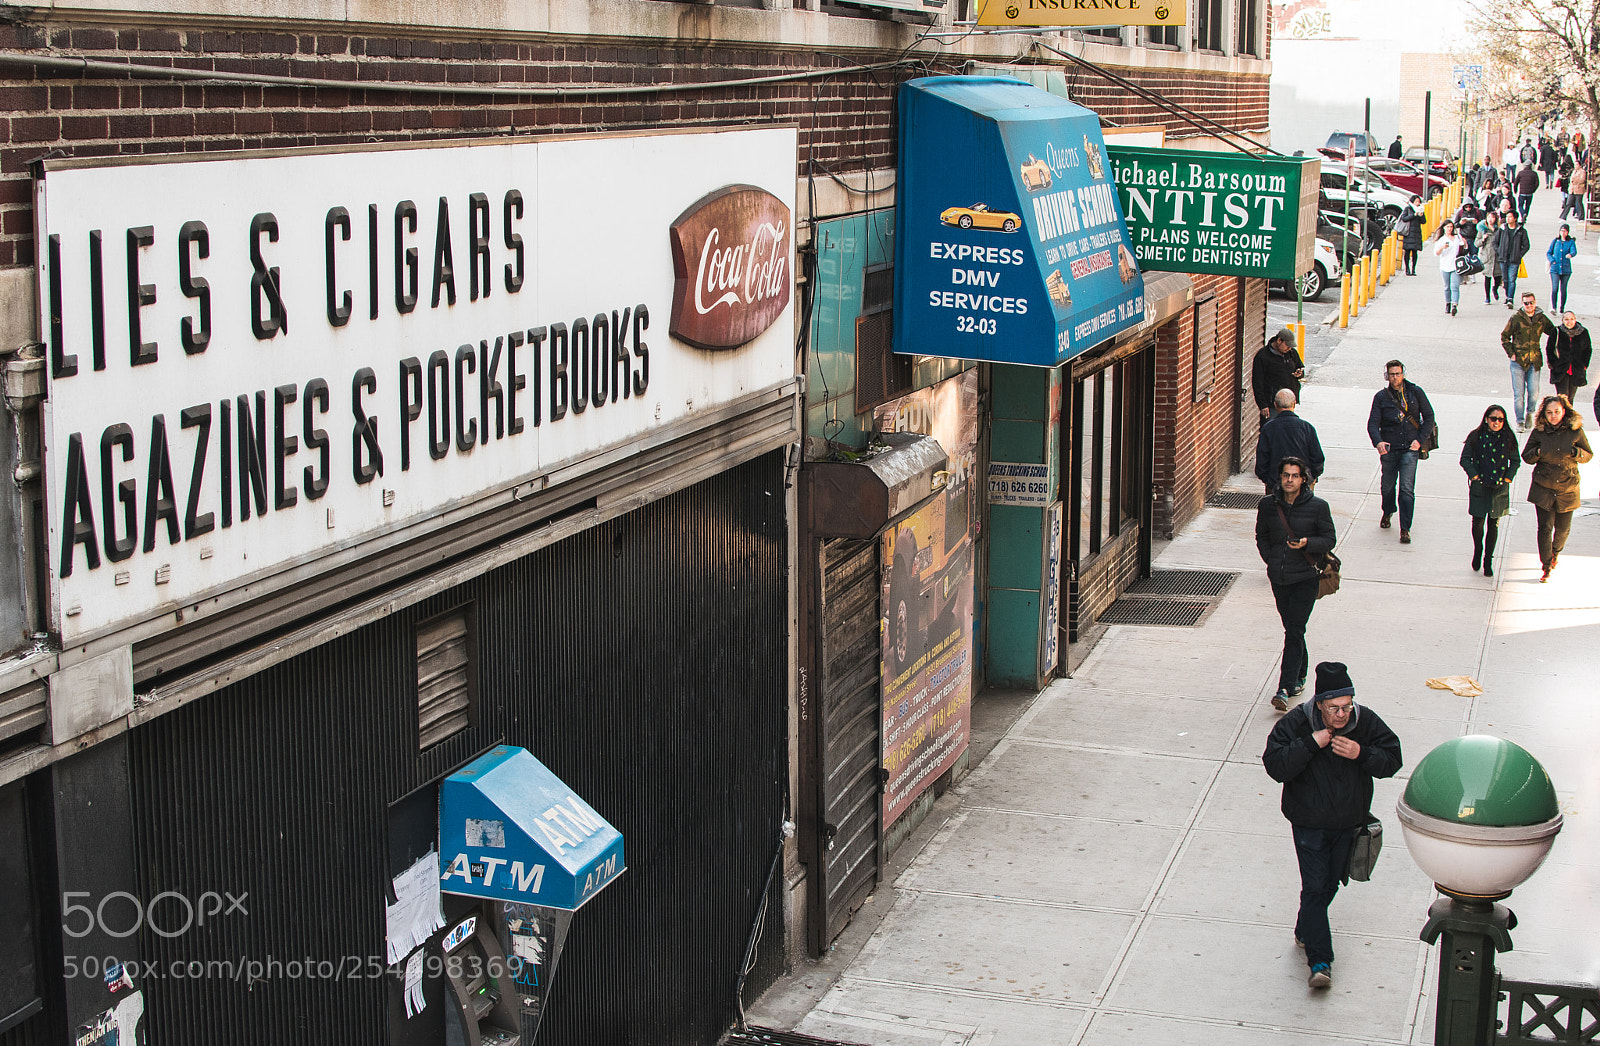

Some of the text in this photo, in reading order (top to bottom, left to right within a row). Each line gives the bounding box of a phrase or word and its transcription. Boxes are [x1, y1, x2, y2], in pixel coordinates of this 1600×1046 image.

[1028, 0, 1140, 10] INSURANCE
[1046, 141, 1080, 179] Queens
[1109, 158, 1286, 193] ichael.Barsoum
[1032, 183, 1118, 243] DRIVING SCHOOL
[1124, 187, 1284, 231] NTIST
[1045, 247, 1061, 265] LEARN
[1059, 244, 1067, 260] TO
[1065, 240, 1079, 258] DRIVE
[1141, 227, 1190, 245] PLANS
[1197, 230, 1273, 250] WELCOME
[694, 219, 786, 315] Coca-Cola
[930, 242, 1024, 265] EXPRESS
[1088, 249, 1114, 273] INSURANCE
[1192, 248, 1270, 268] DENTISTRY
[48, 188, 525, 380] LIES & CIGARS
[951, 268, 1001, 288] DMV
[929, 290, 1028, 315] SERVICES
[956, 315, 997, 335] 32-03
[1074, 320, 1092, 342] EXPRESS
[1091, 315, 1100, 334] DMV
[1099, 308, 1117, 329] SERVICES
[59, 303, 650, 579] AGAZINES & POCKETBOOKS
[1005, 464, 1031, 478] TRUCKING
[1029, 465, 1049, 478] SCHOOL
[988, 481, 1048, 494] (718) 626 6260
[899, 698, 909, 718] BUS
[930, 706, 946, 738] (718)
[533, 795, 604, 856] ATM
[440, 852, 546, 894] ATM
[581, 853, 617, 896] ATM
